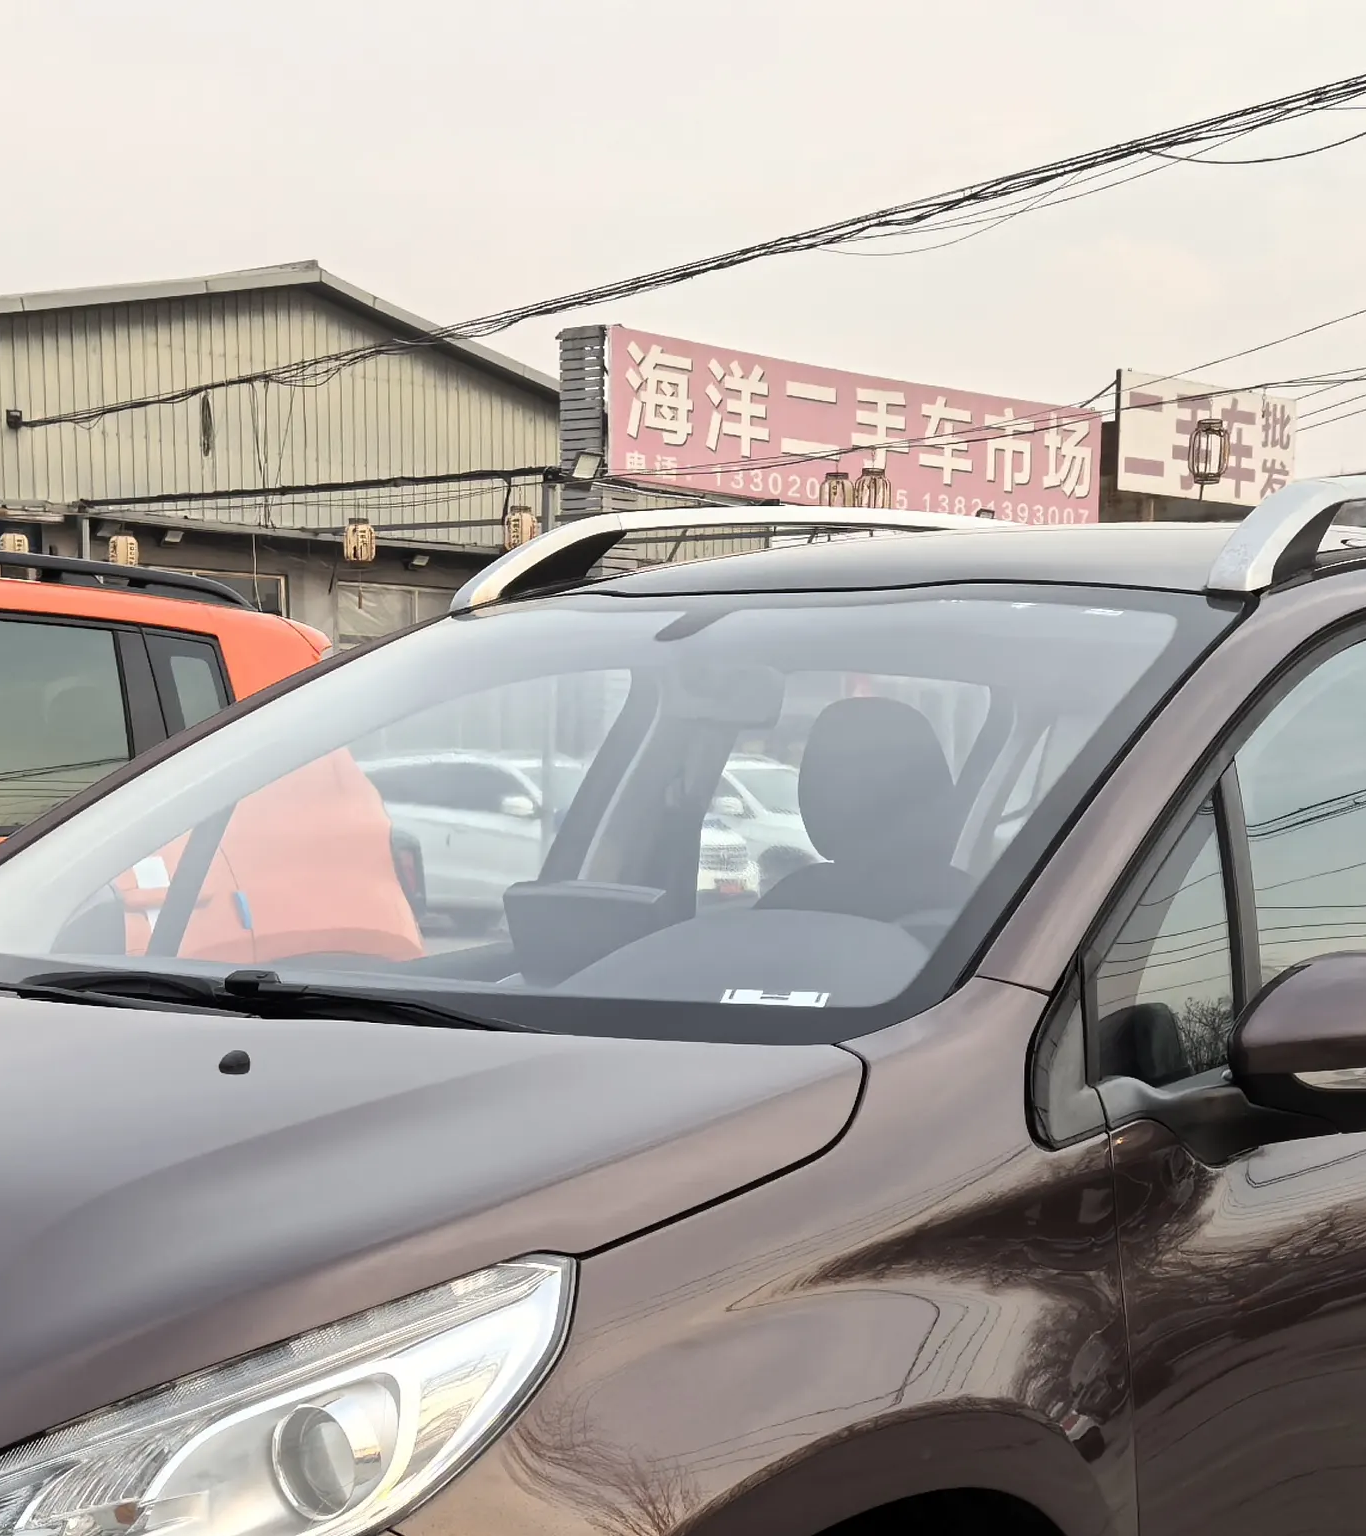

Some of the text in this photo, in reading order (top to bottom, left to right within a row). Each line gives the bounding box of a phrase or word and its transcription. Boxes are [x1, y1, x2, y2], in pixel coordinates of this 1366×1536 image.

[625, 341, 1094, 500] 海洋二手车市场
